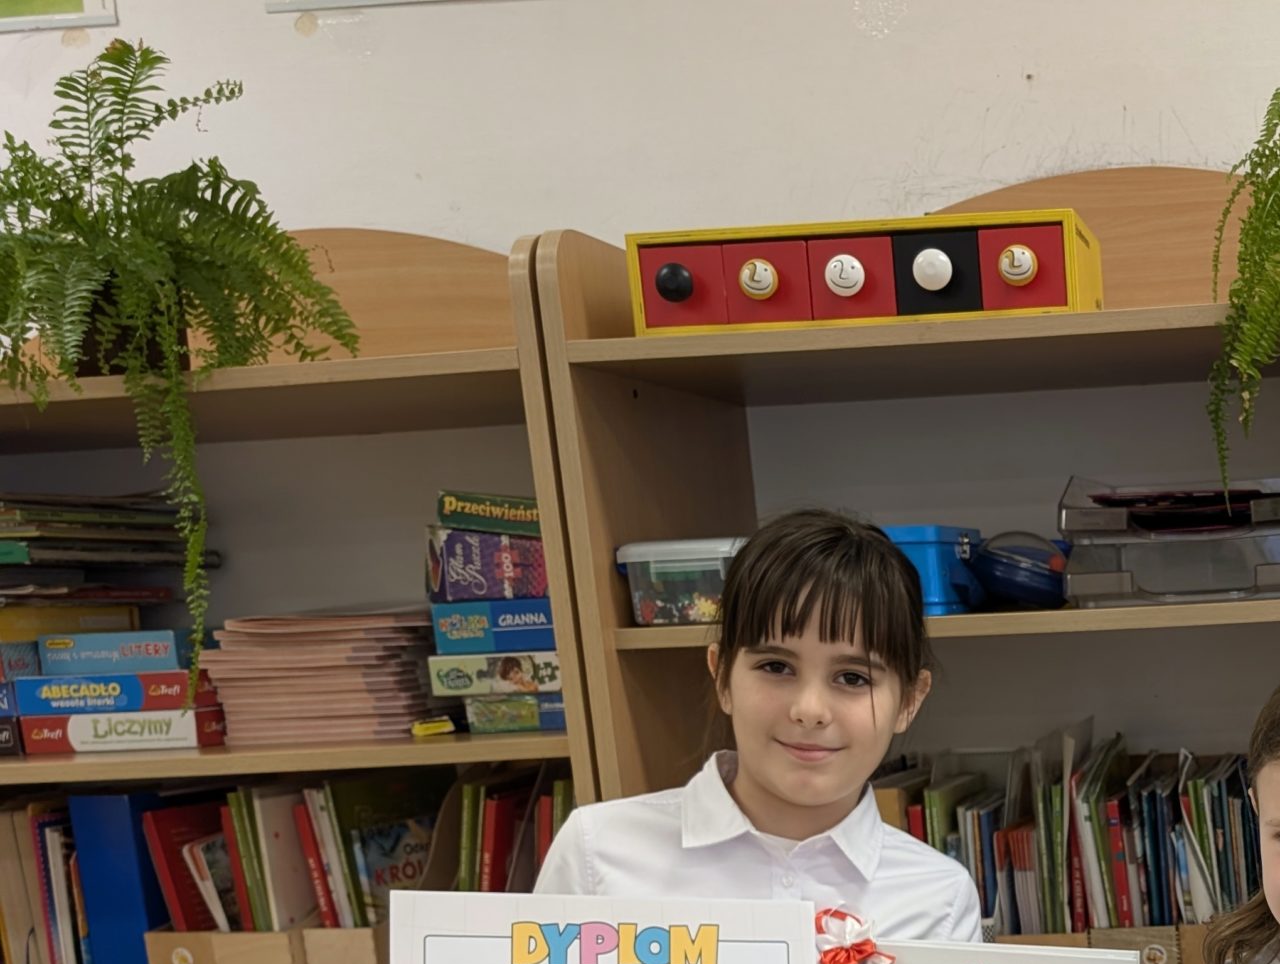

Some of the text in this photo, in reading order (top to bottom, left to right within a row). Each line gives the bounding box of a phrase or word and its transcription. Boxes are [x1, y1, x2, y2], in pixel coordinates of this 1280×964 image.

[443, 495, 541, 523] Przeciwieńst
[501, 552, 514, 578] 100
[498, 612, 548, 627] GRANNA
[120, 643, 170, 656] LITERY
[40, 682, 121, 700] ABECADŁO
[92, 718, 173, 740] Liczymy
